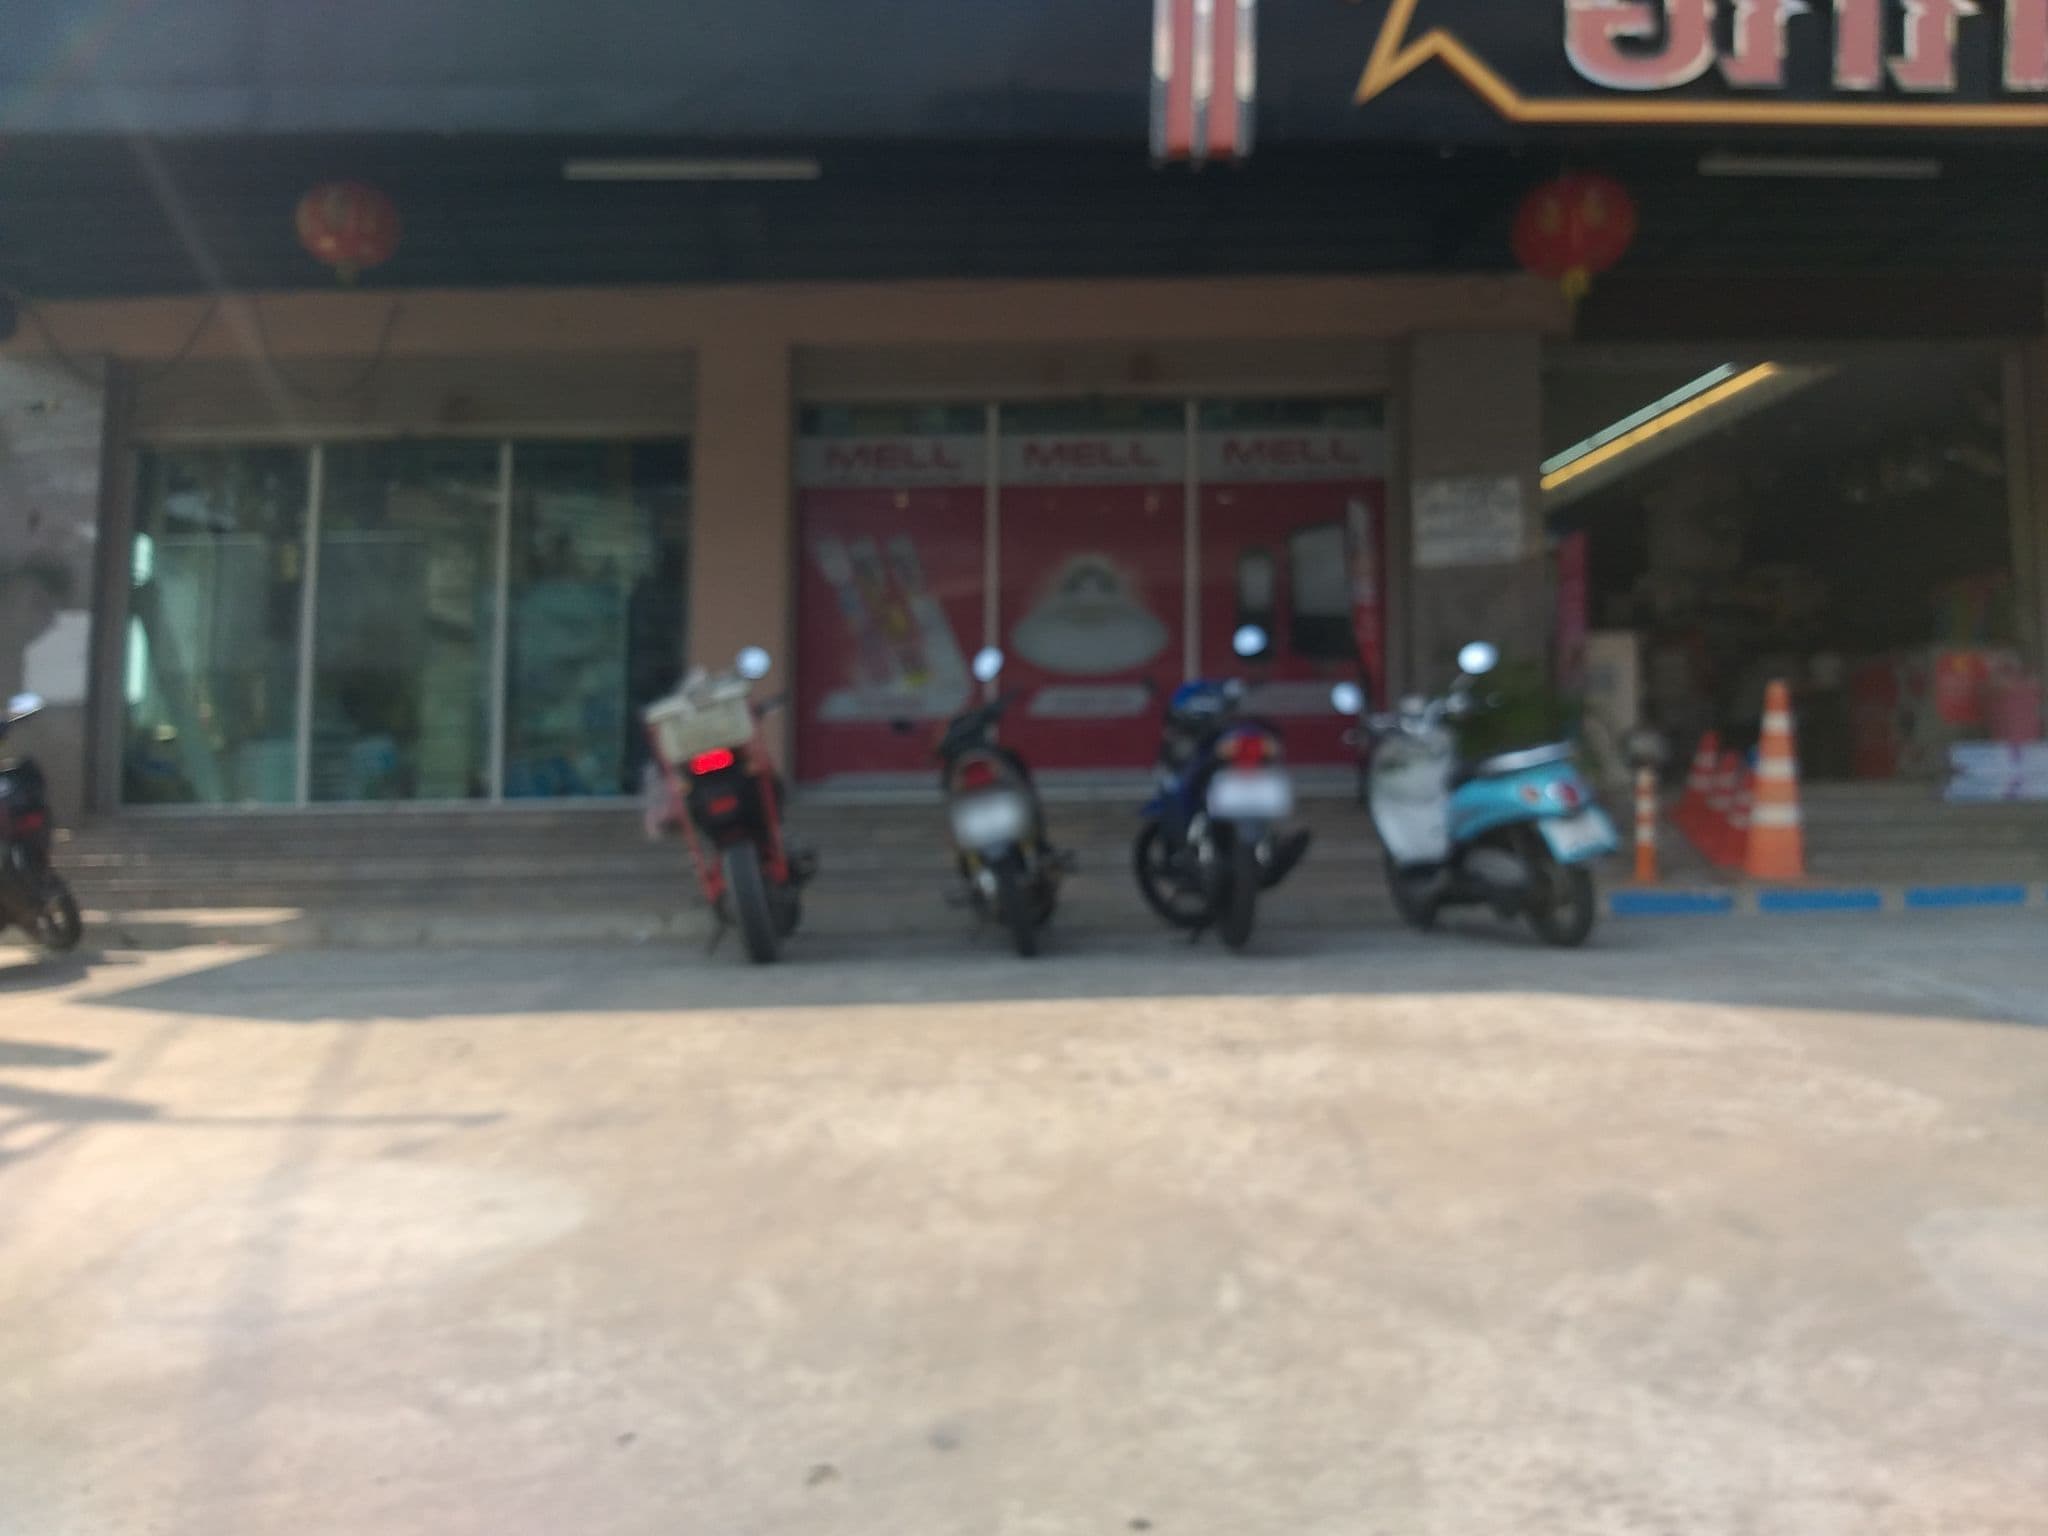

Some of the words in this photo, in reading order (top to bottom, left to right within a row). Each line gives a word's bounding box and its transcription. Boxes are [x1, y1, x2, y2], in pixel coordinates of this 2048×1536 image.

[825, 443, 962, 470] MELL
[1022, 442, 1160, 468] MELL
[1222, 439, 1360, 465] MELL
